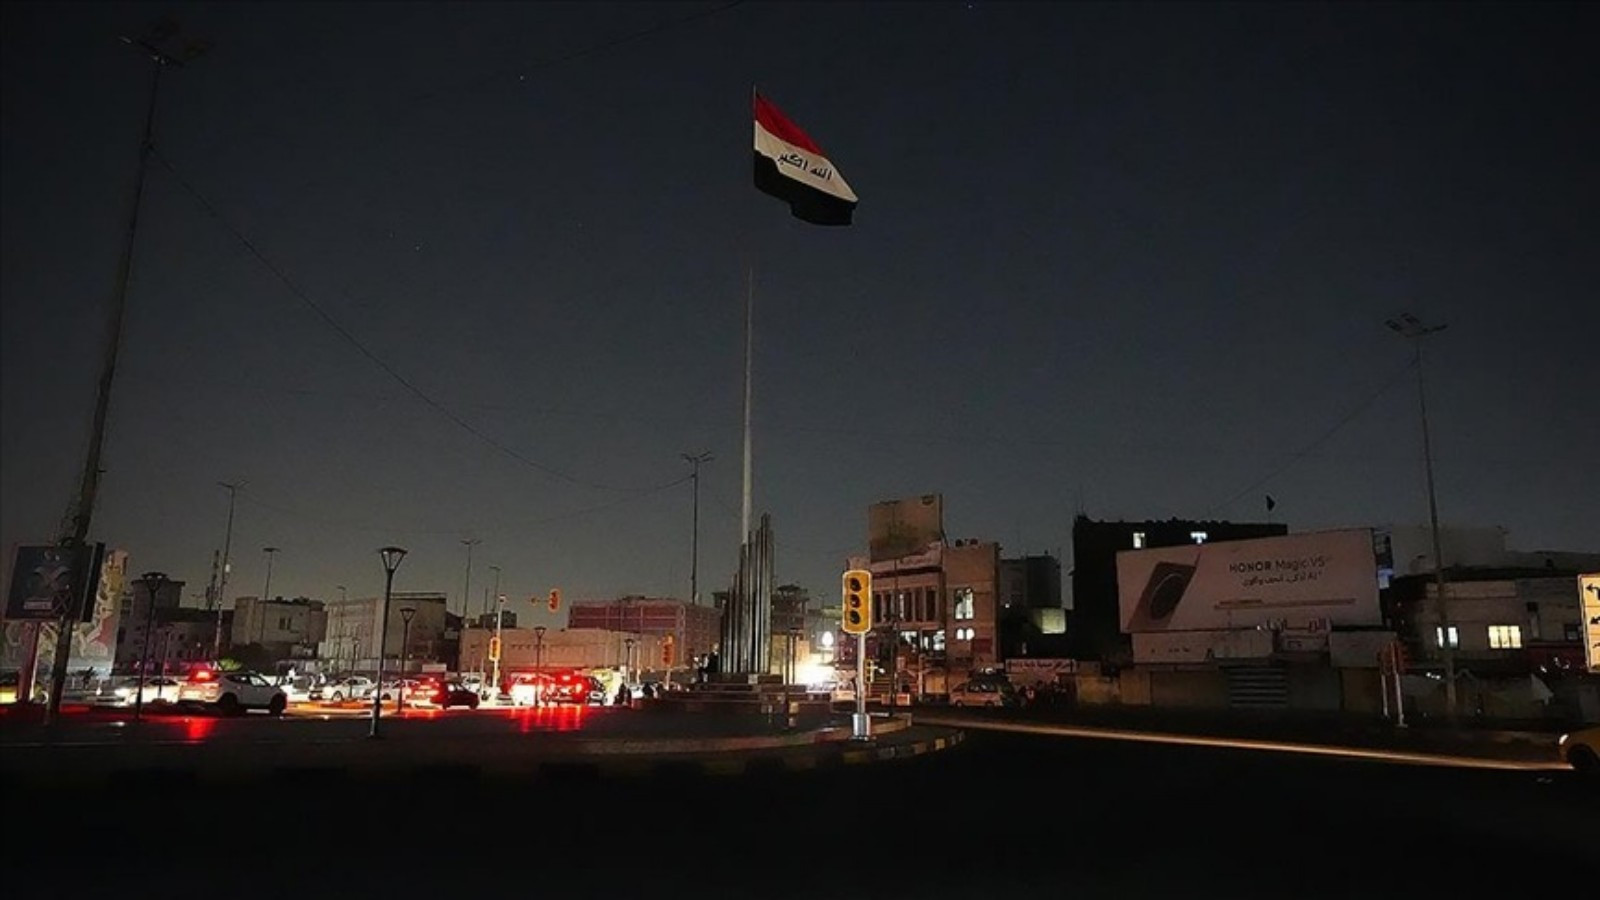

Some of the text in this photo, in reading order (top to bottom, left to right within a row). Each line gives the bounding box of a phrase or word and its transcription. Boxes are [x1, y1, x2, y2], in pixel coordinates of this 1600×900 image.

[810, 167, 832, 181] الله
[1229, 560, 1271, 573] HONOR
[1275, 558, 1307, 571] Magic
